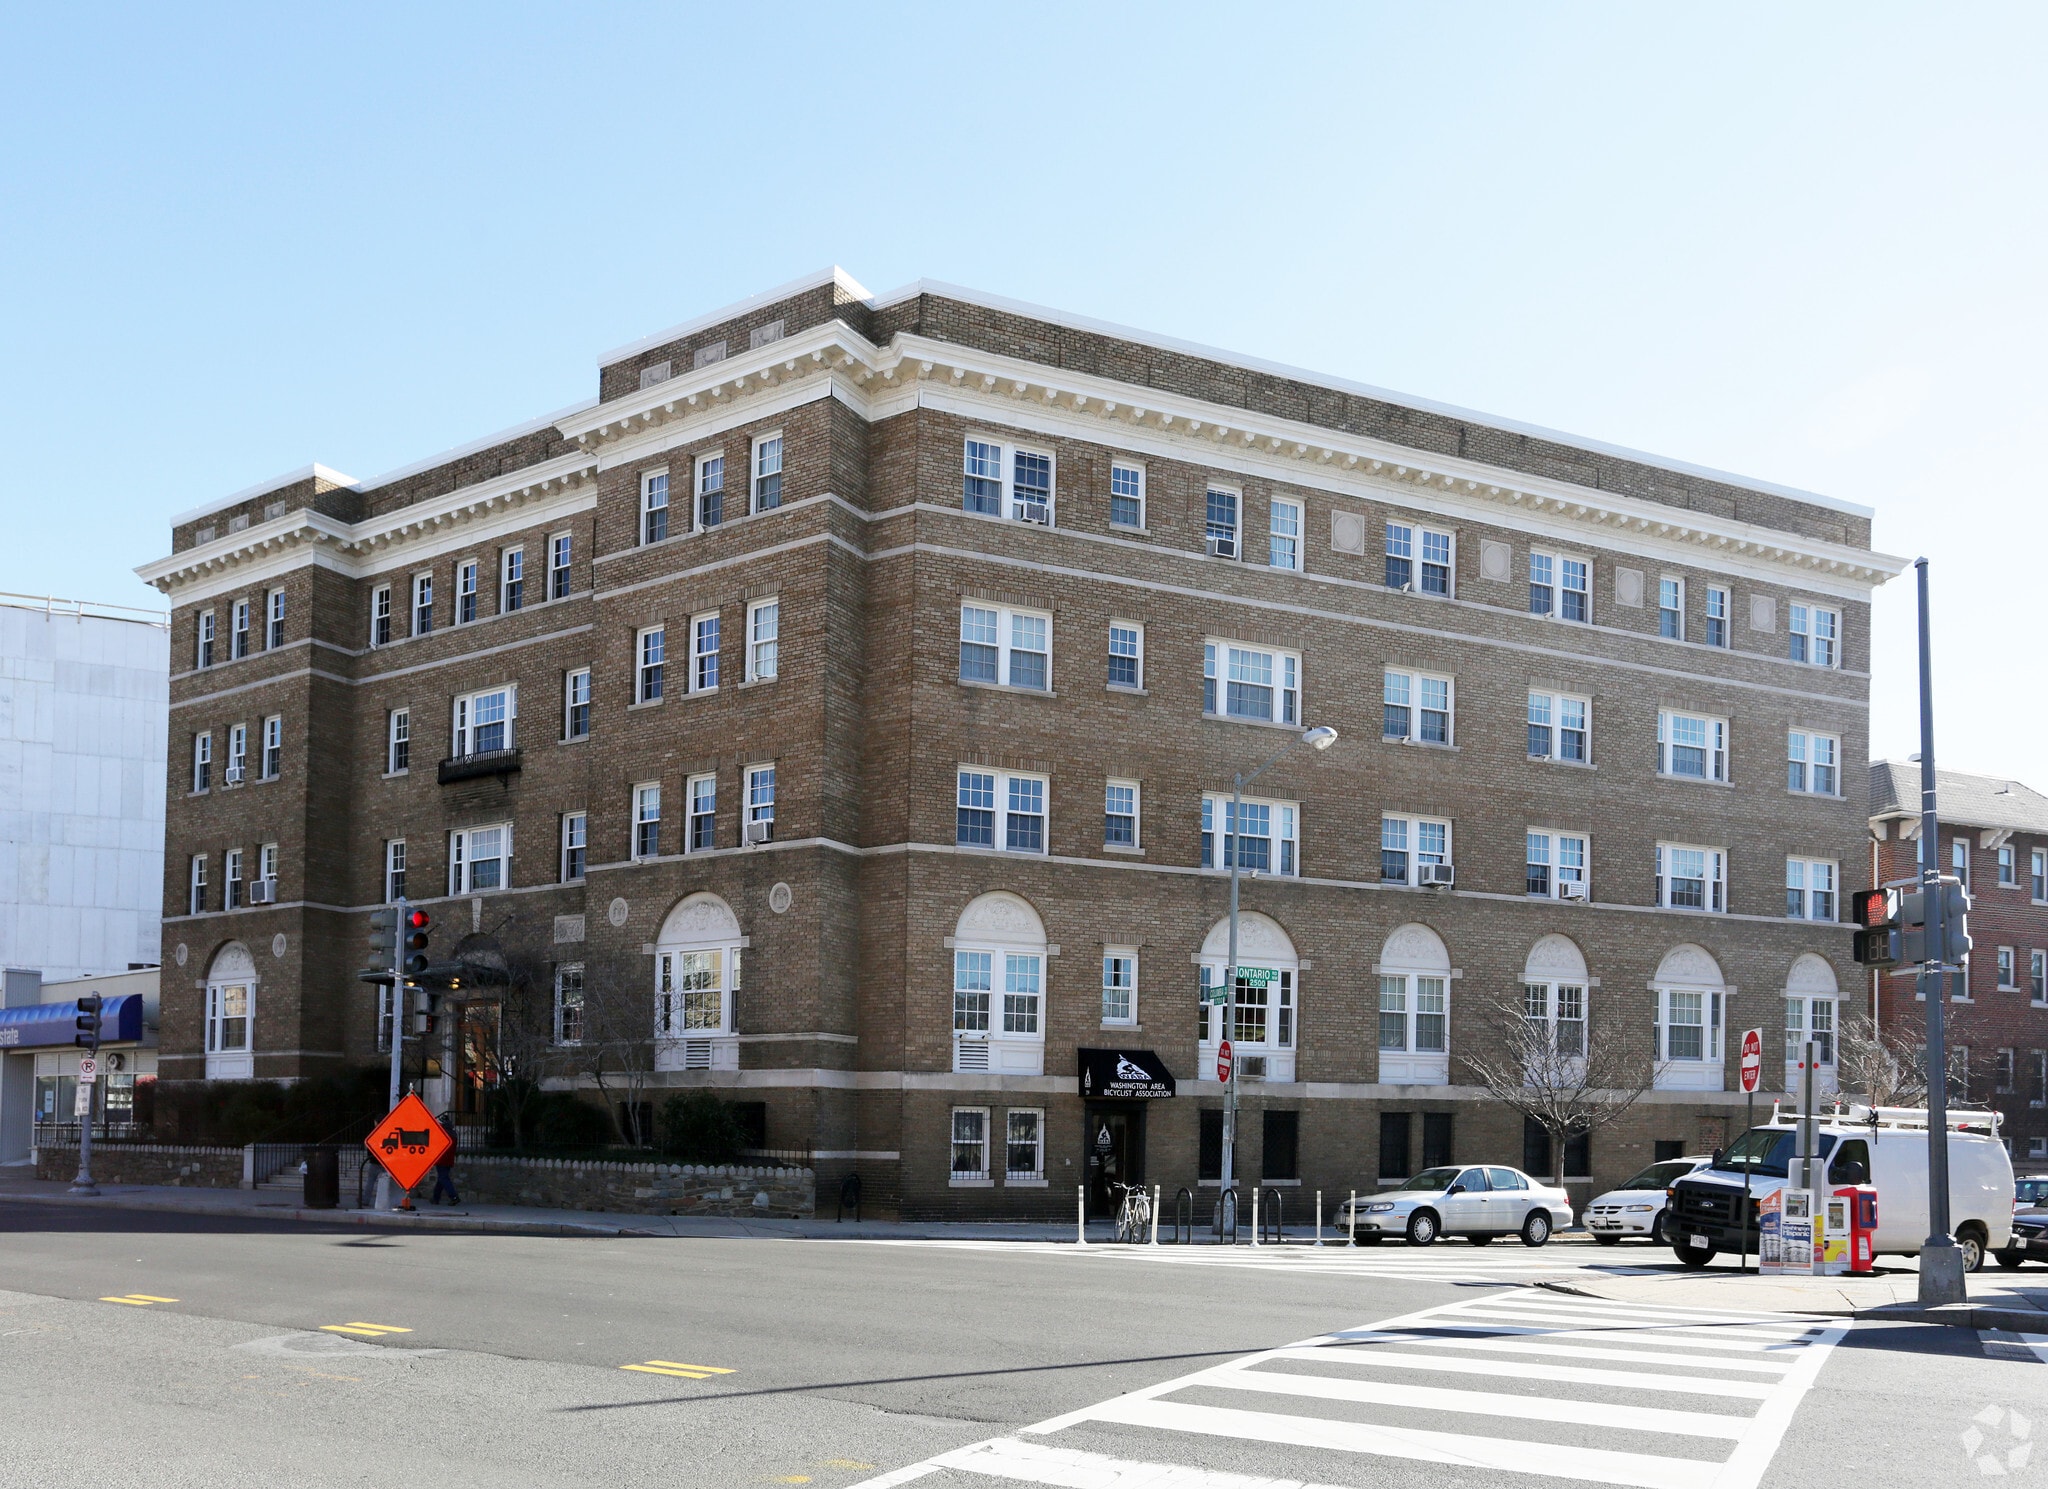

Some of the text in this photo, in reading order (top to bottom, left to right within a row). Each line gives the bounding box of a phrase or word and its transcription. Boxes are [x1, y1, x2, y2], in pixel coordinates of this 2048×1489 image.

[1239, 968, 1270, 980] ONTARIO
[1744, 1041, 1759, 1053] DO NOT
[1744, 1070, 1755, 1080] ENTER
[1110, 1082, 1148, 1090] WASHINGTON
[1103, 1089, 1172, 1098] BICYCLIST ASSOCIATION
